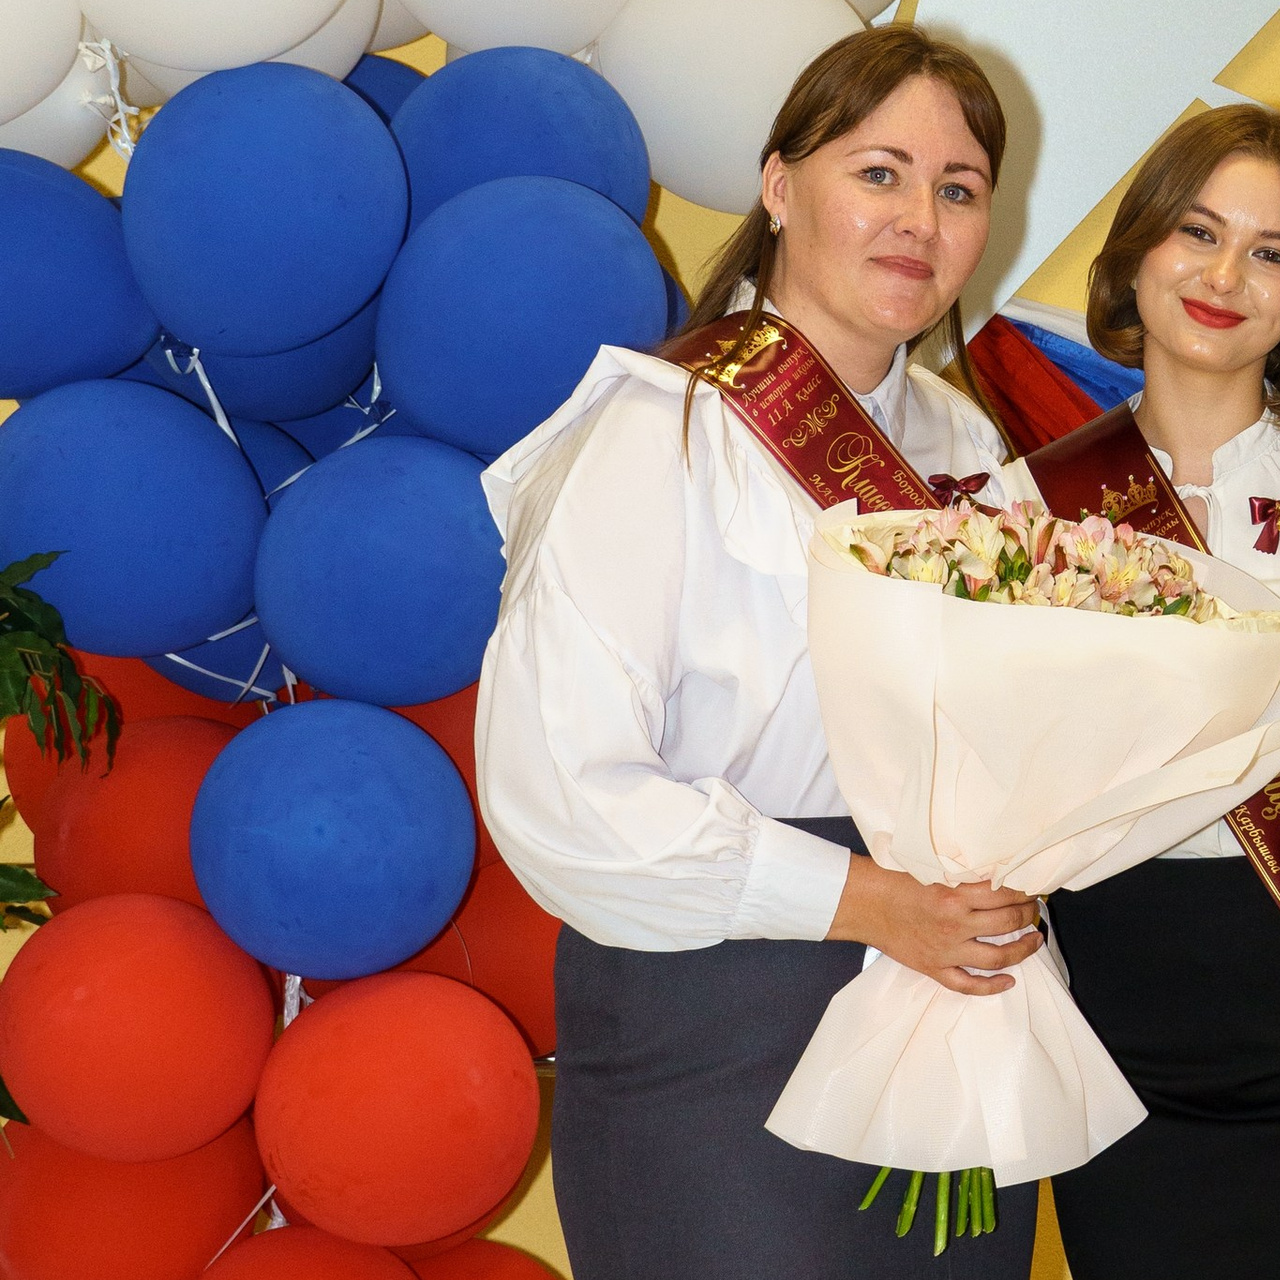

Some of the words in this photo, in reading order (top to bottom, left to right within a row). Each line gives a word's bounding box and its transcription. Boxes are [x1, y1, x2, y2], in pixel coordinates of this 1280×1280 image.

[742, 371, 777, 408] Лучший
[777, 346, 809, 374] выпуск
[752, 408, 759, 417] в
[760, 379, 792, 410] истории
[792, 356, 816, 380] школы
[795, 374, 822, 402] класс
[1139, 508, 1176, 533] ыпуск
[1153, 517, 1180, 537] колы
